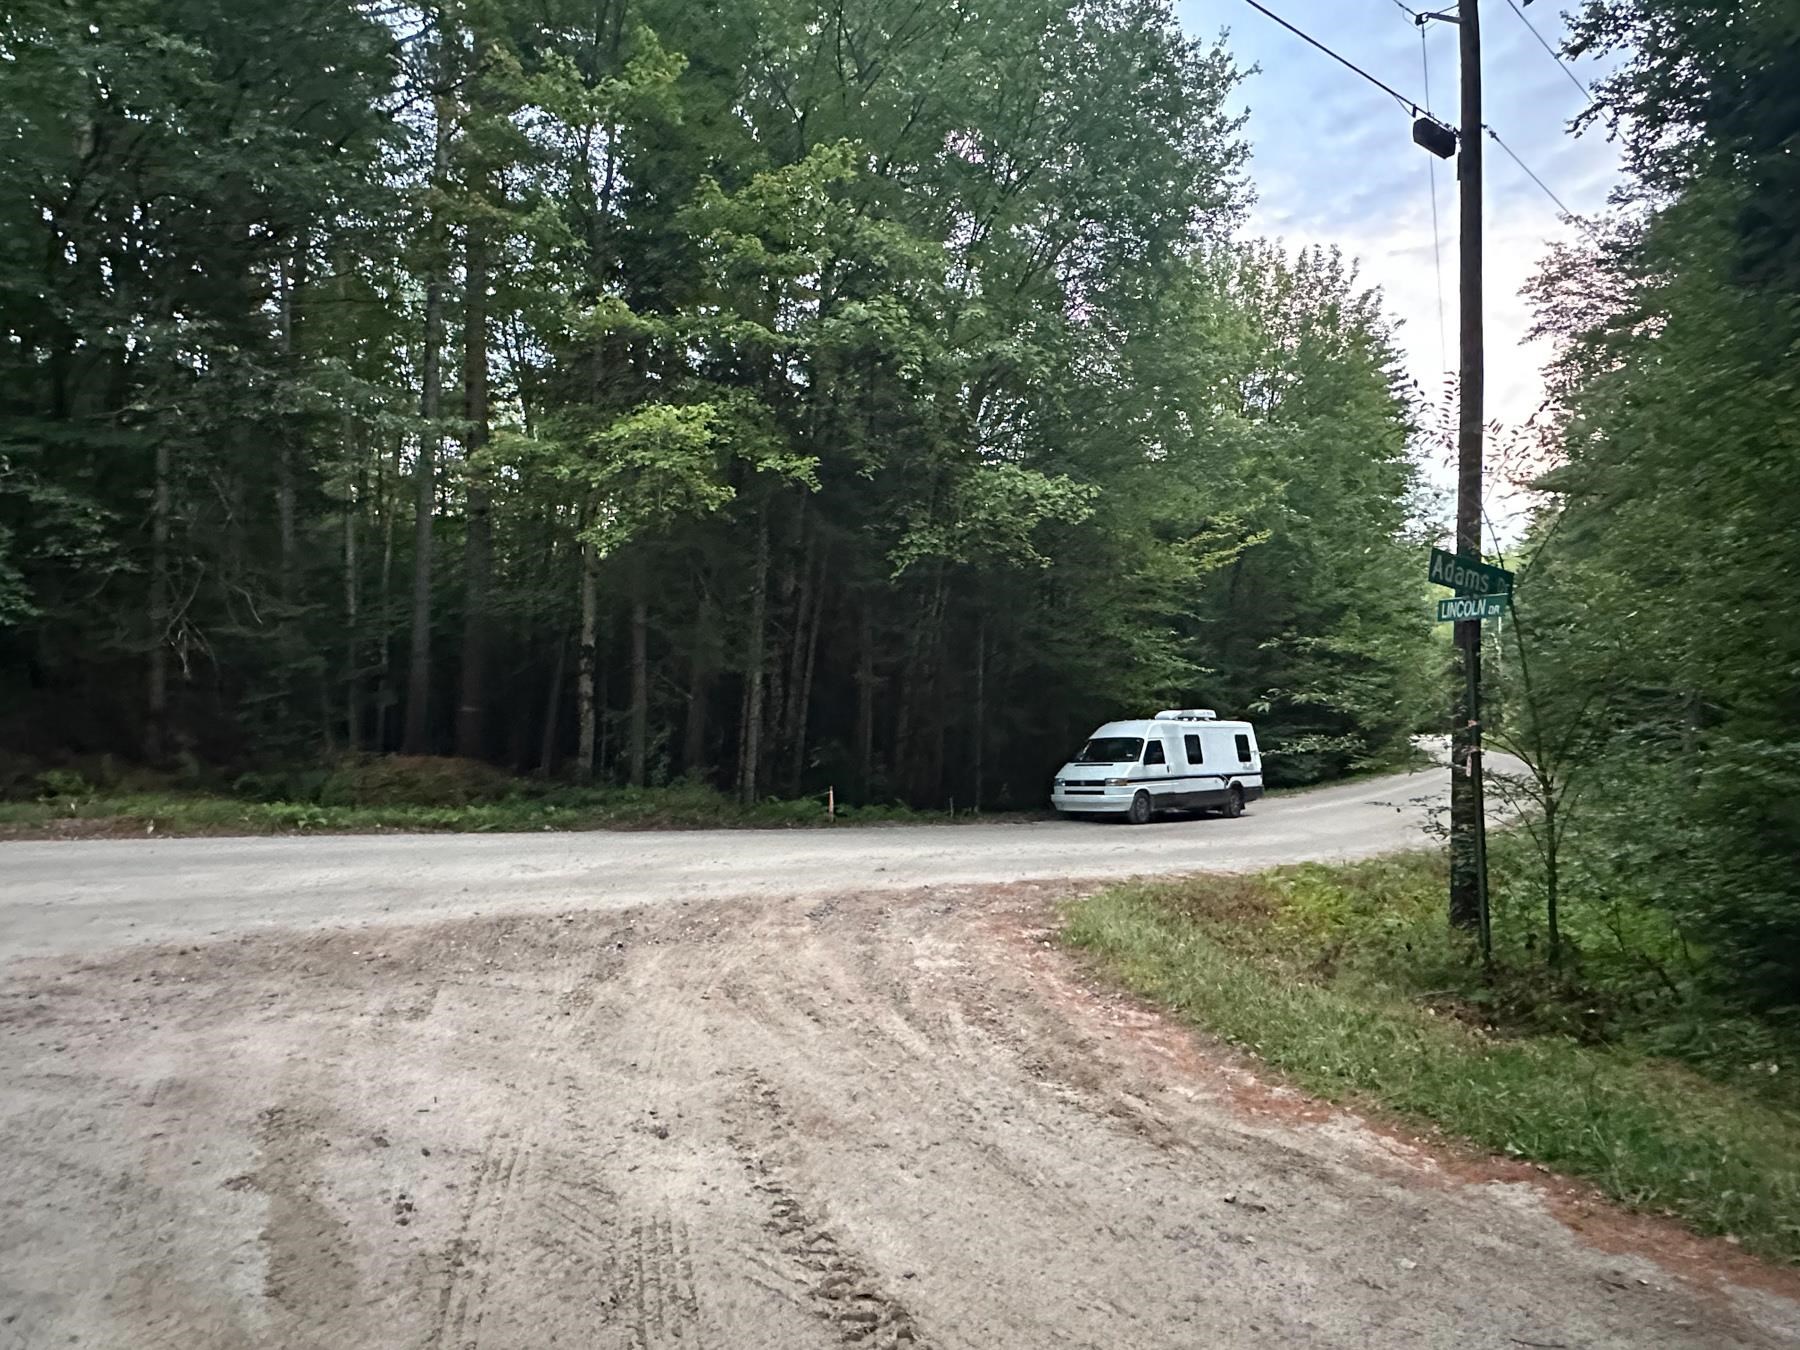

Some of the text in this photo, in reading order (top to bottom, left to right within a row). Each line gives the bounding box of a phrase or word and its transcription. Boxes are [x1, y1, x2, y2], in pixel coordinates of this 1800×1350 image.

[1432, 555, 1489, 593] Adams
[1441, 599, 1500, 618] LINCOLN DR
